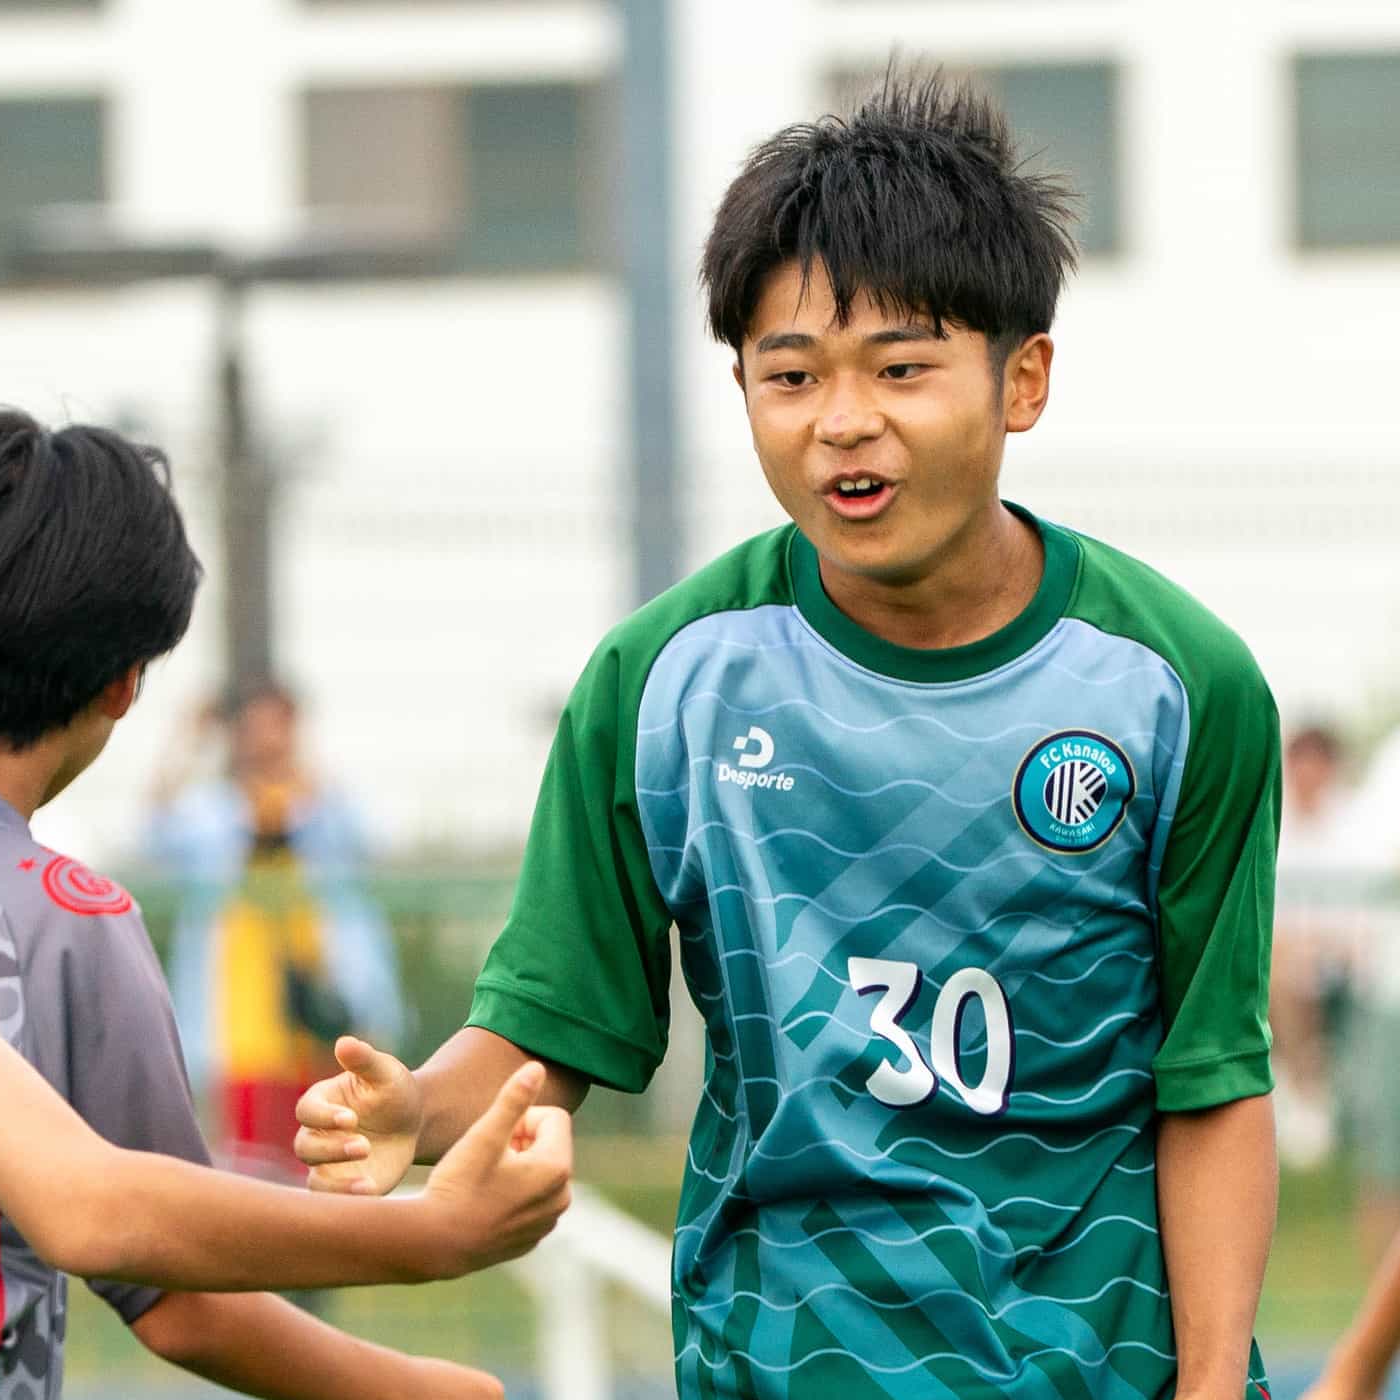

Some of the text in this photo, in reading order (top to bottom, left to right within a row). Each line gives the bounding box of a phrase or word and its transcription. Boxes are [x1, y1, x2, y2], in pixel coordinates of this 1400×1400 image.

[1040, 742, 1117, 775] FC Kanaloa
[718, 763, 795, 791] Desporte
[847, 957, 1015, 1116] 30
